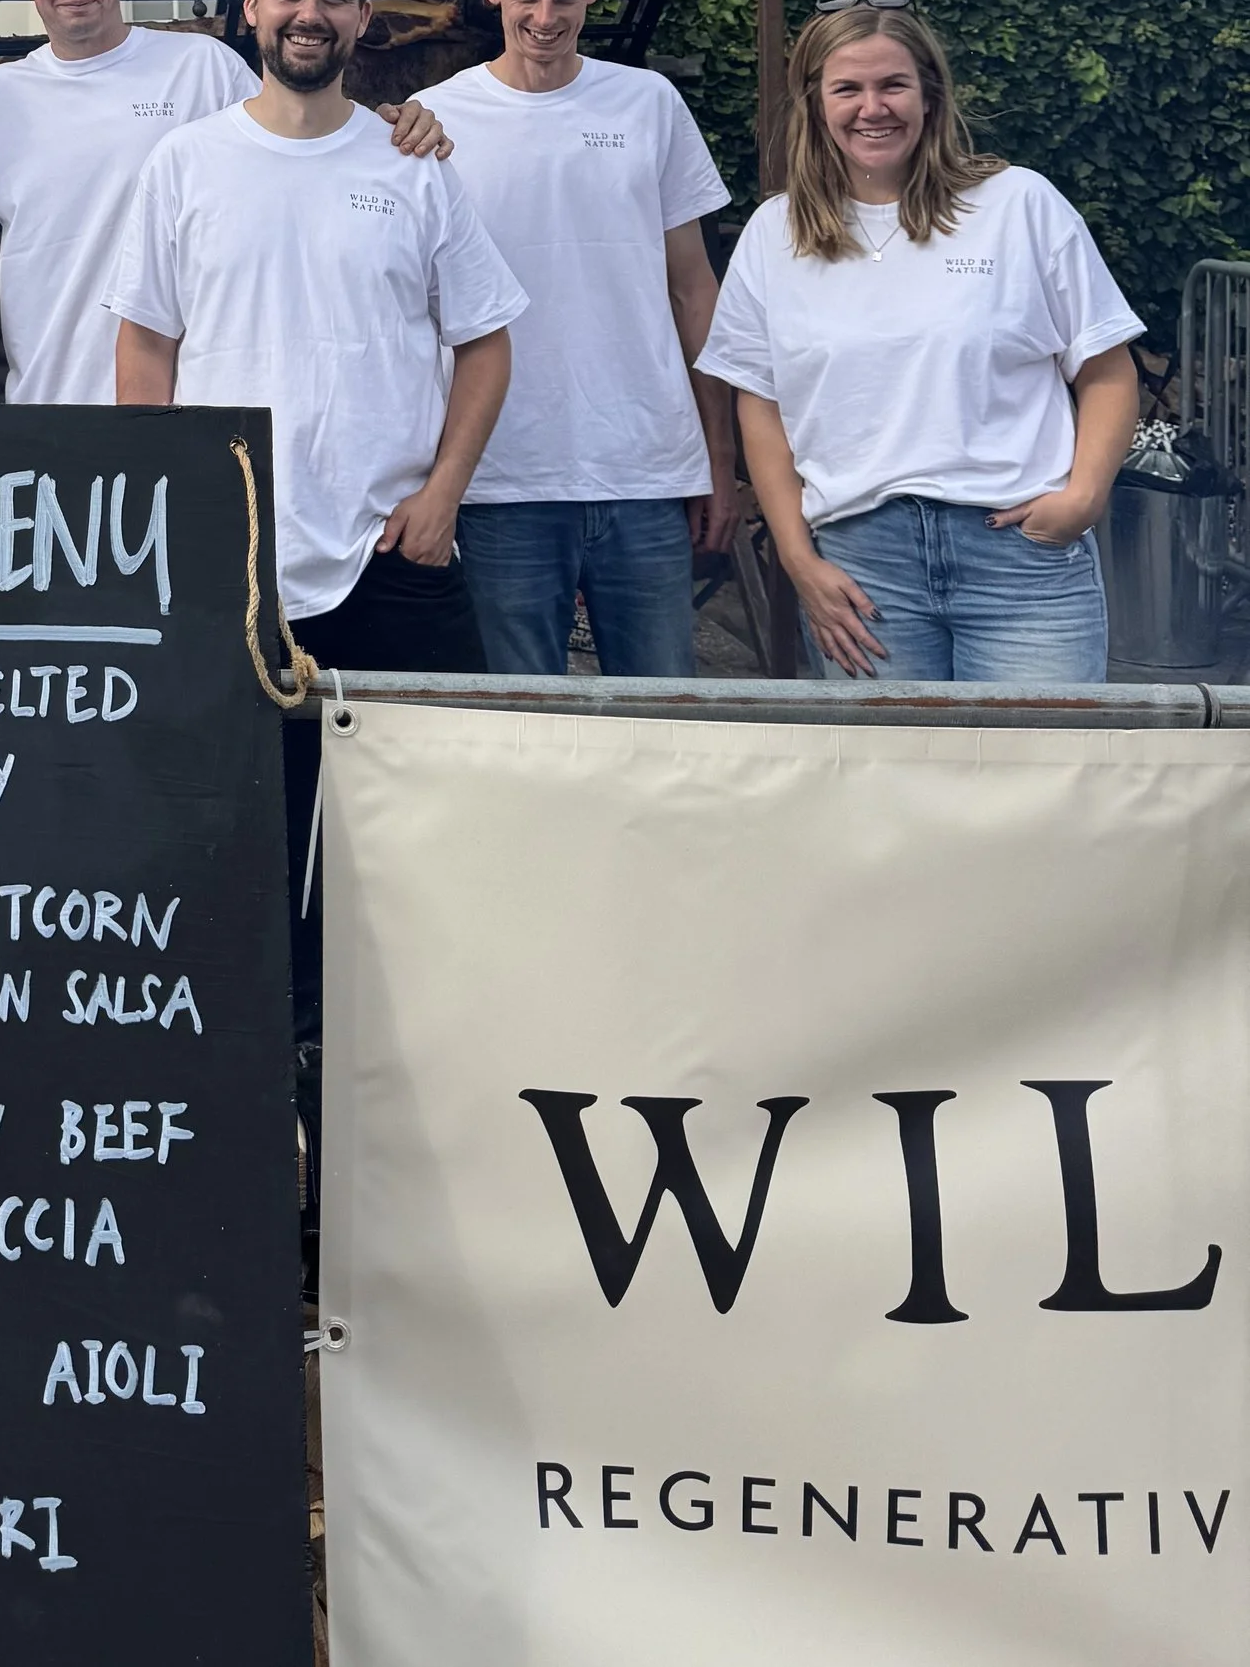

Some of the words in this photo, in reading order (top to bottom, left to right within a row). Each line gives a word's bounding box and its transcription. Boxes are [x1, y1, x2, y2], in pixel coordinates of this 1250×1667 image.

[132, 102, 159, 110] WILD
[134, 109, 175, 117] NATURE
[582, 132, 608, 140] WILD
[584, 140, 625, 148] NATURE
[350, 193, 379, 204] WILD
[383, 198, 396, 208] BY
[351, 202, 395, 215] NATURE
[945, 258, 975, 266] WILD
[980, 258, 996, 266] BY
[946, 266, 994, 276] NATURE
[63, 970, 202, 1034] SALSA
[60, 1100, 194, 1164] BEEF
[43, 1340, 205, 1414] AIOLI
